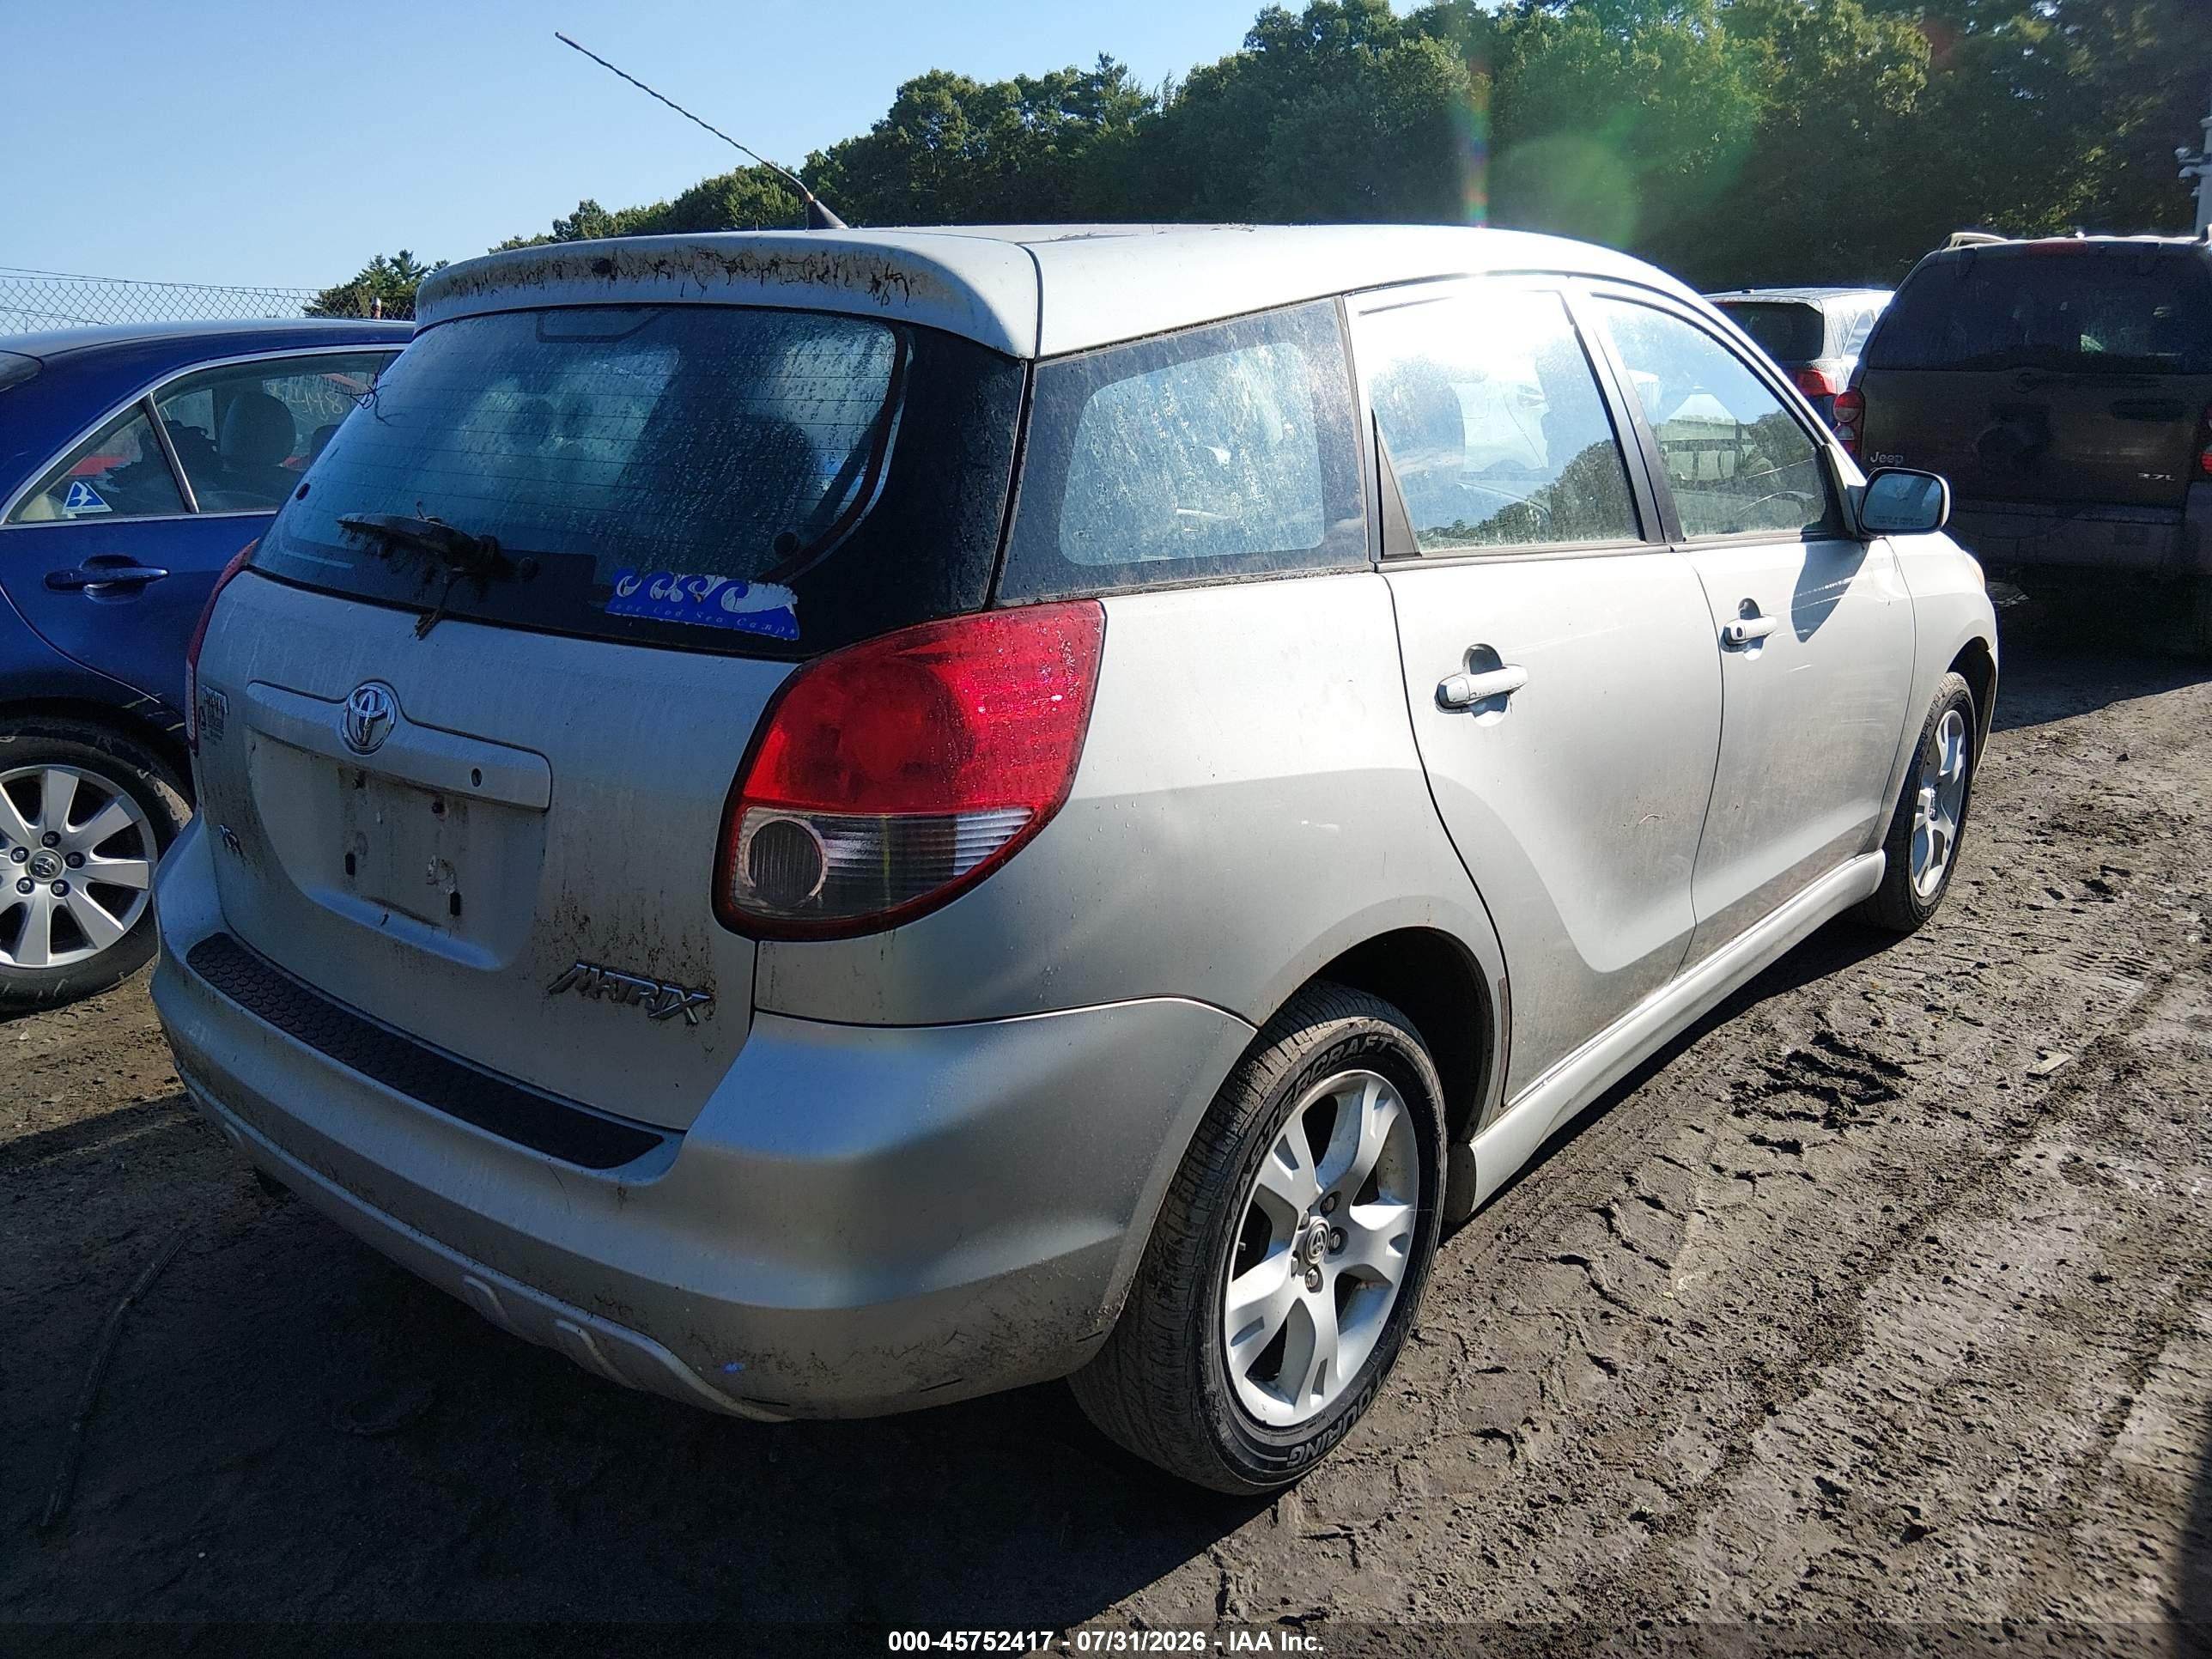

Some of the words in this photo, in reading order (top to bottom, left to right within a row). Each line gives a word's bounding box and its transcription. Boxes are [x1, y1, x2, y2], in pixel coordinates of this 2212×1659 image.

[1869, 451, 1904, 466] Jeep
[695, 611, 724, 623] Sea
[1224, 1034, 1395, 1242] MASTERCRAFT
[1285, 1368, 1388, 1469] TOURING
